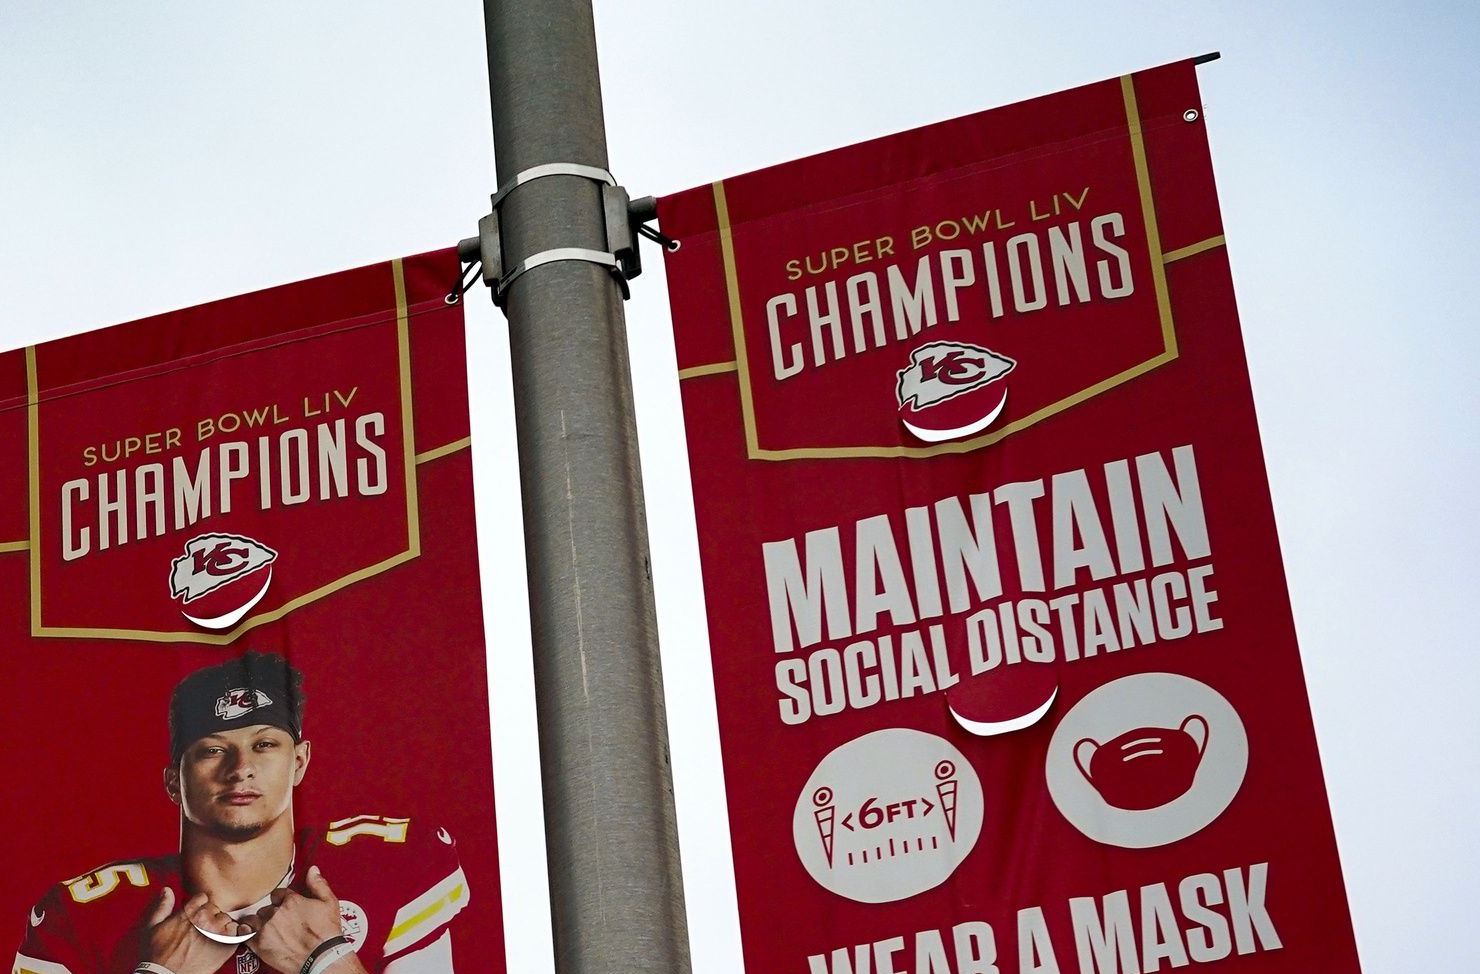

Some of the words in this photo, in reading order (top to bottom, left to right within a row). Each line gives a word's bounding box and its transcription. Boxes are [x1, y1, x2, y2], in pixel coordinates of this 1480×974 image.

[786, 236, 895, 281] SUPER
[911, 209, 1015, 249] BOWL
[1030, 187, 1090, 221] LIV
[765, 212, 1135, 381] CHAMPIONS
[83, 428, 182, 467] SUPER
[197, 404, 289, 441] BOWL
[304, 387, 358, 417] LIV
[919, 350, 986, 384] KC
[61, 412, 388, 562] CHAMPIONS
[192, 542, 250, 577] KC
[761, 444, 1212, 653] MAINTAIN
[775, 624, 959, 725] SOCIAL
[965, 564, 1224, 677] DISTANCE
